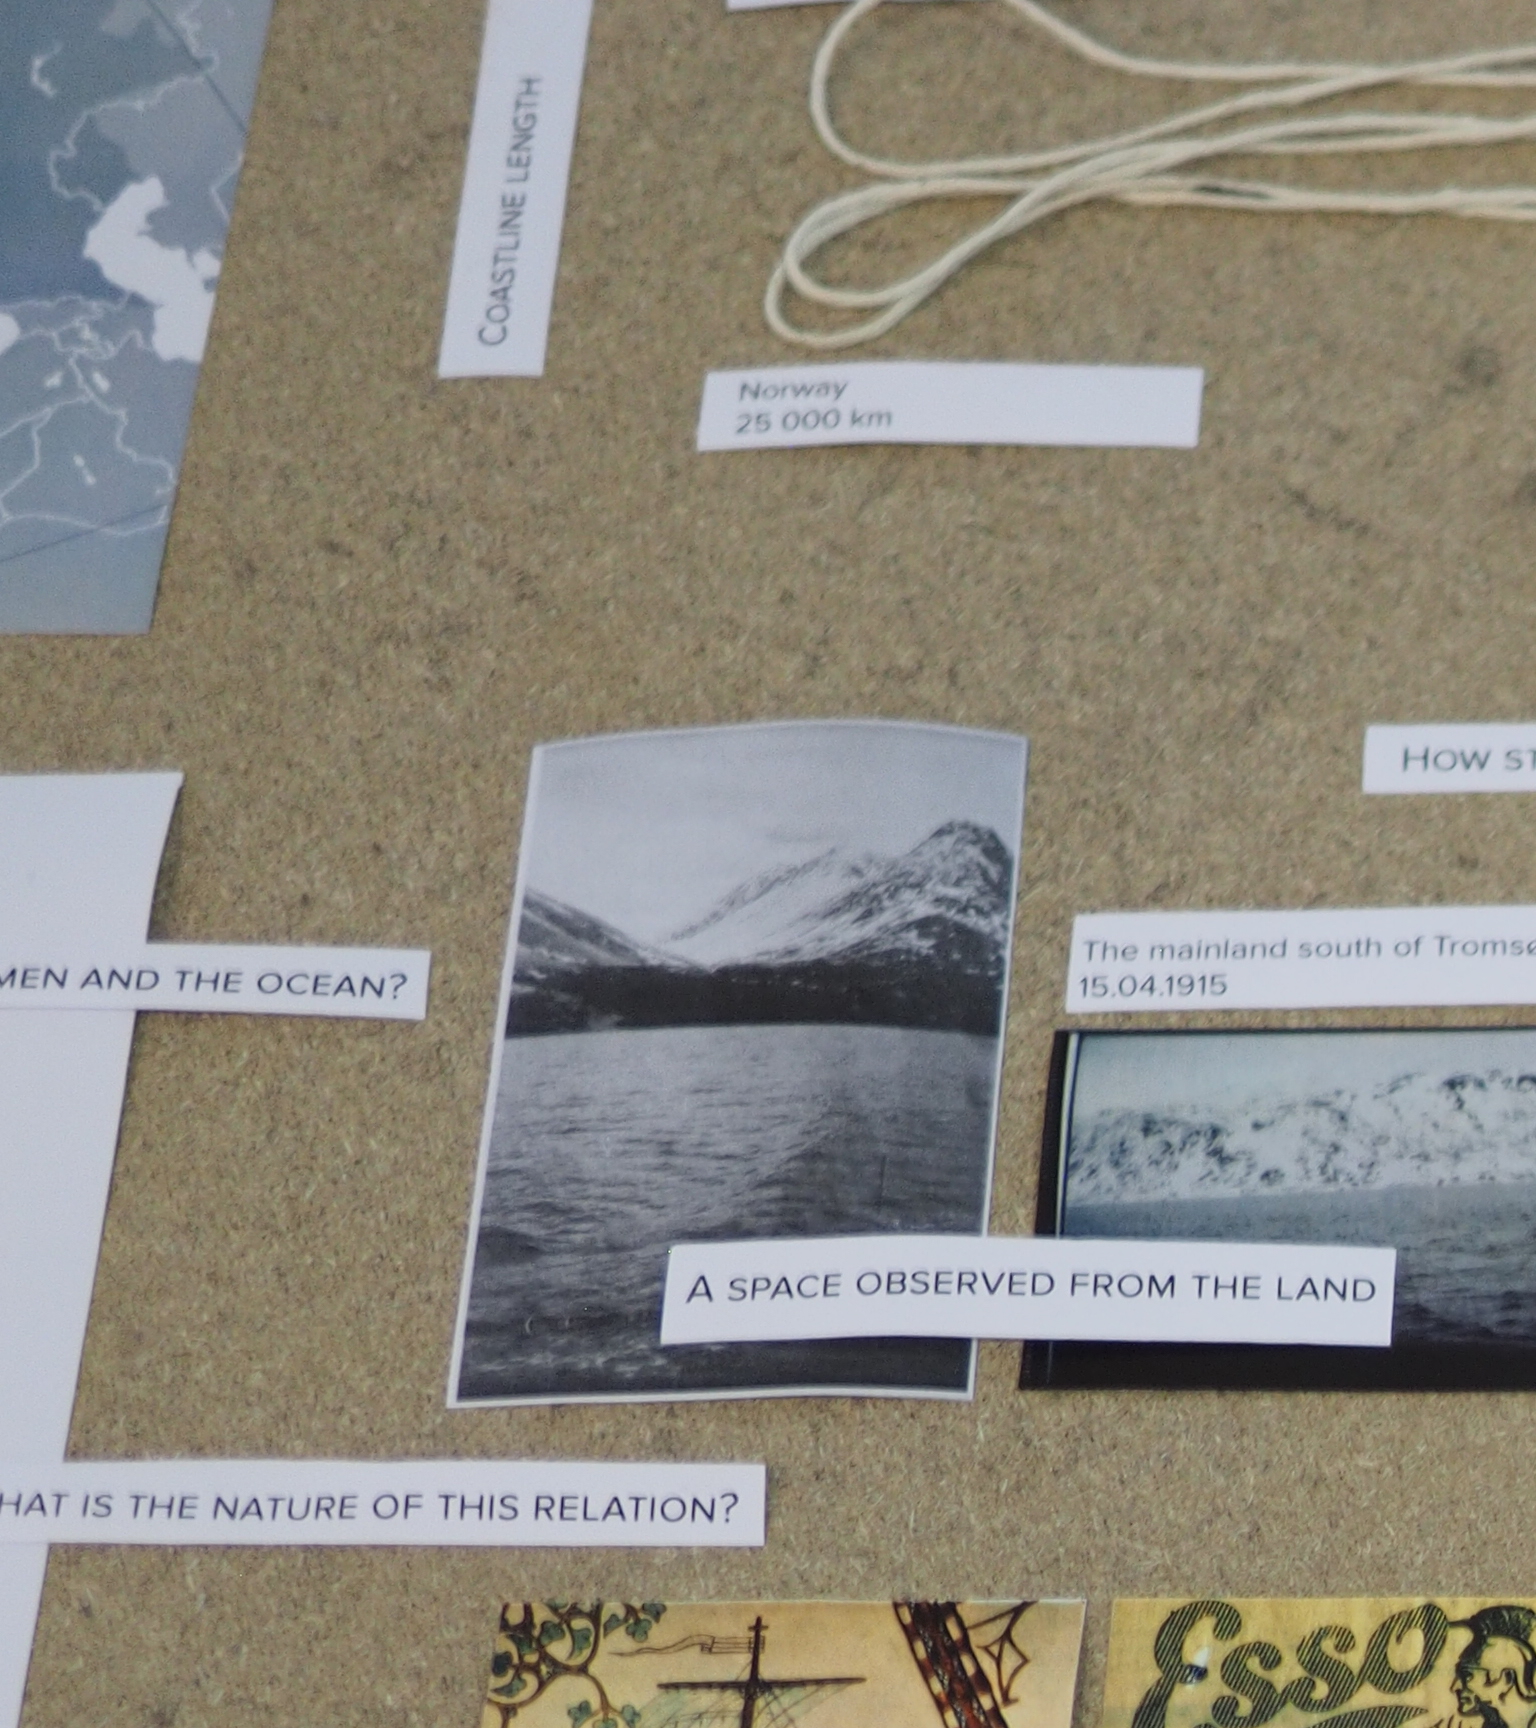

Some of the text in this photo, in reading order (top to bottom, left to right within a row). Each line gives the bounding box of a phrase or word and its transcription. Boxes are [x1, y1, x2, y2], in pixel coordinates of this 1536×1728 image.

[477, 74, 542, 346] COASTLINE LENGTH
[738, 380, 849, 402] Norway
[735, 407, 893, 436] 25 000 km
[1401, 745, 1492, 773] HOW
[1083, 938, 1140, 963] The
[1148, 937, 1288, 961] mainland
[1298, 936, 1383, 959] south
[1392, 934, 1424, 958] of
[79, 967, 160, 991] AND
[175, 968, 243, 994] THE
[256, 972, 408, 1000] OCEAN?
[1079, 973, 1228, 998] 15.04.1915
[685, 1270, 1377, 1304] A SPACE OBSERVED FROM THE LAND
[81, 1493, 113, 1519] IS
[129, 1493, 198, 1520] THE
[212, 1494, 358, 1521] NATURE
[371, 1493, 423, 1521] OF
[437, 1493, 519, 1522] THIS
[533, 1491, 740, 1524] RELATION?
